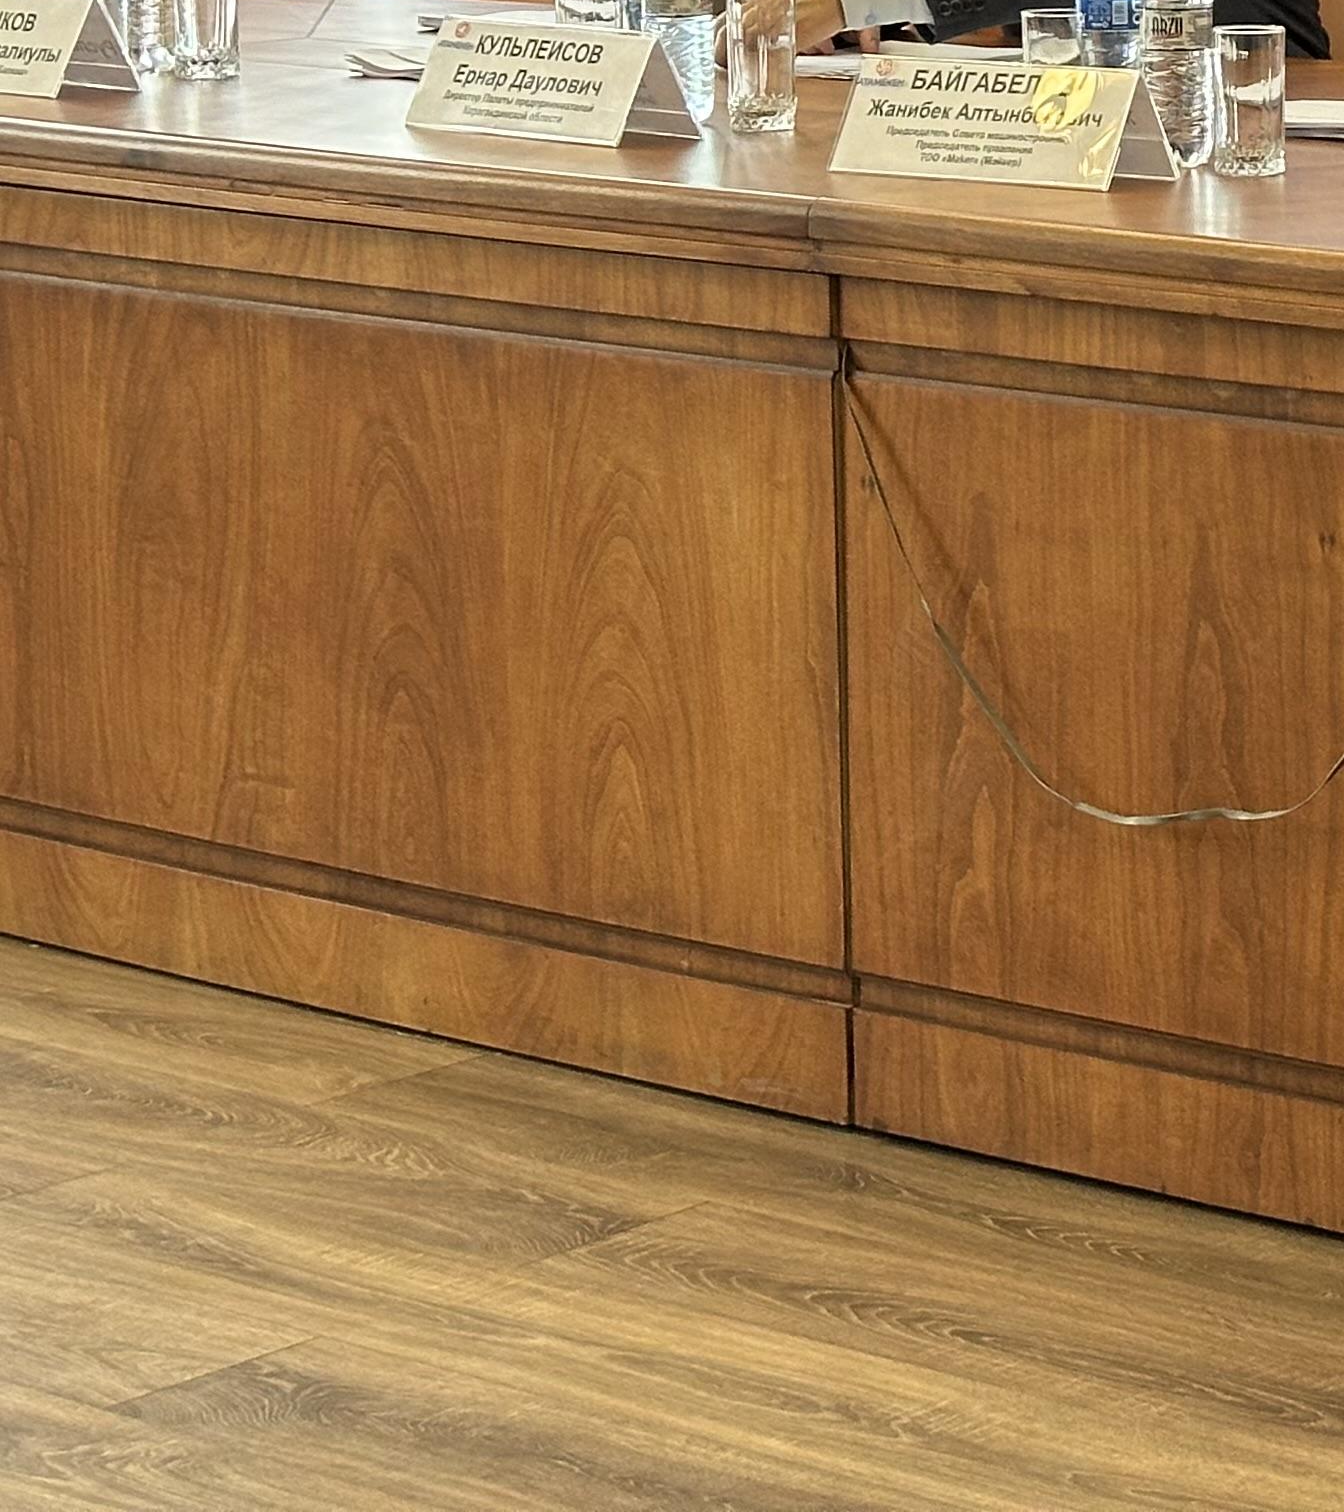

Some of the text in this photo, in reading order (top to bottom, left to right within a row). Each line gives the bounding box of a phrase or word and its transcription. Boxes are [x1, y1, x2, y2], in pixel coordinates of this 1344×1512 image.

[0, 11, 37, 32] КОВ
[0, 44, 62, 65] алиулы
[453, 64, 604, 96] Ернар Даулович
[911, 66, 1043, 95] БАЙГАБЕЛ
[867, 98, 951, 120] Жанибек
